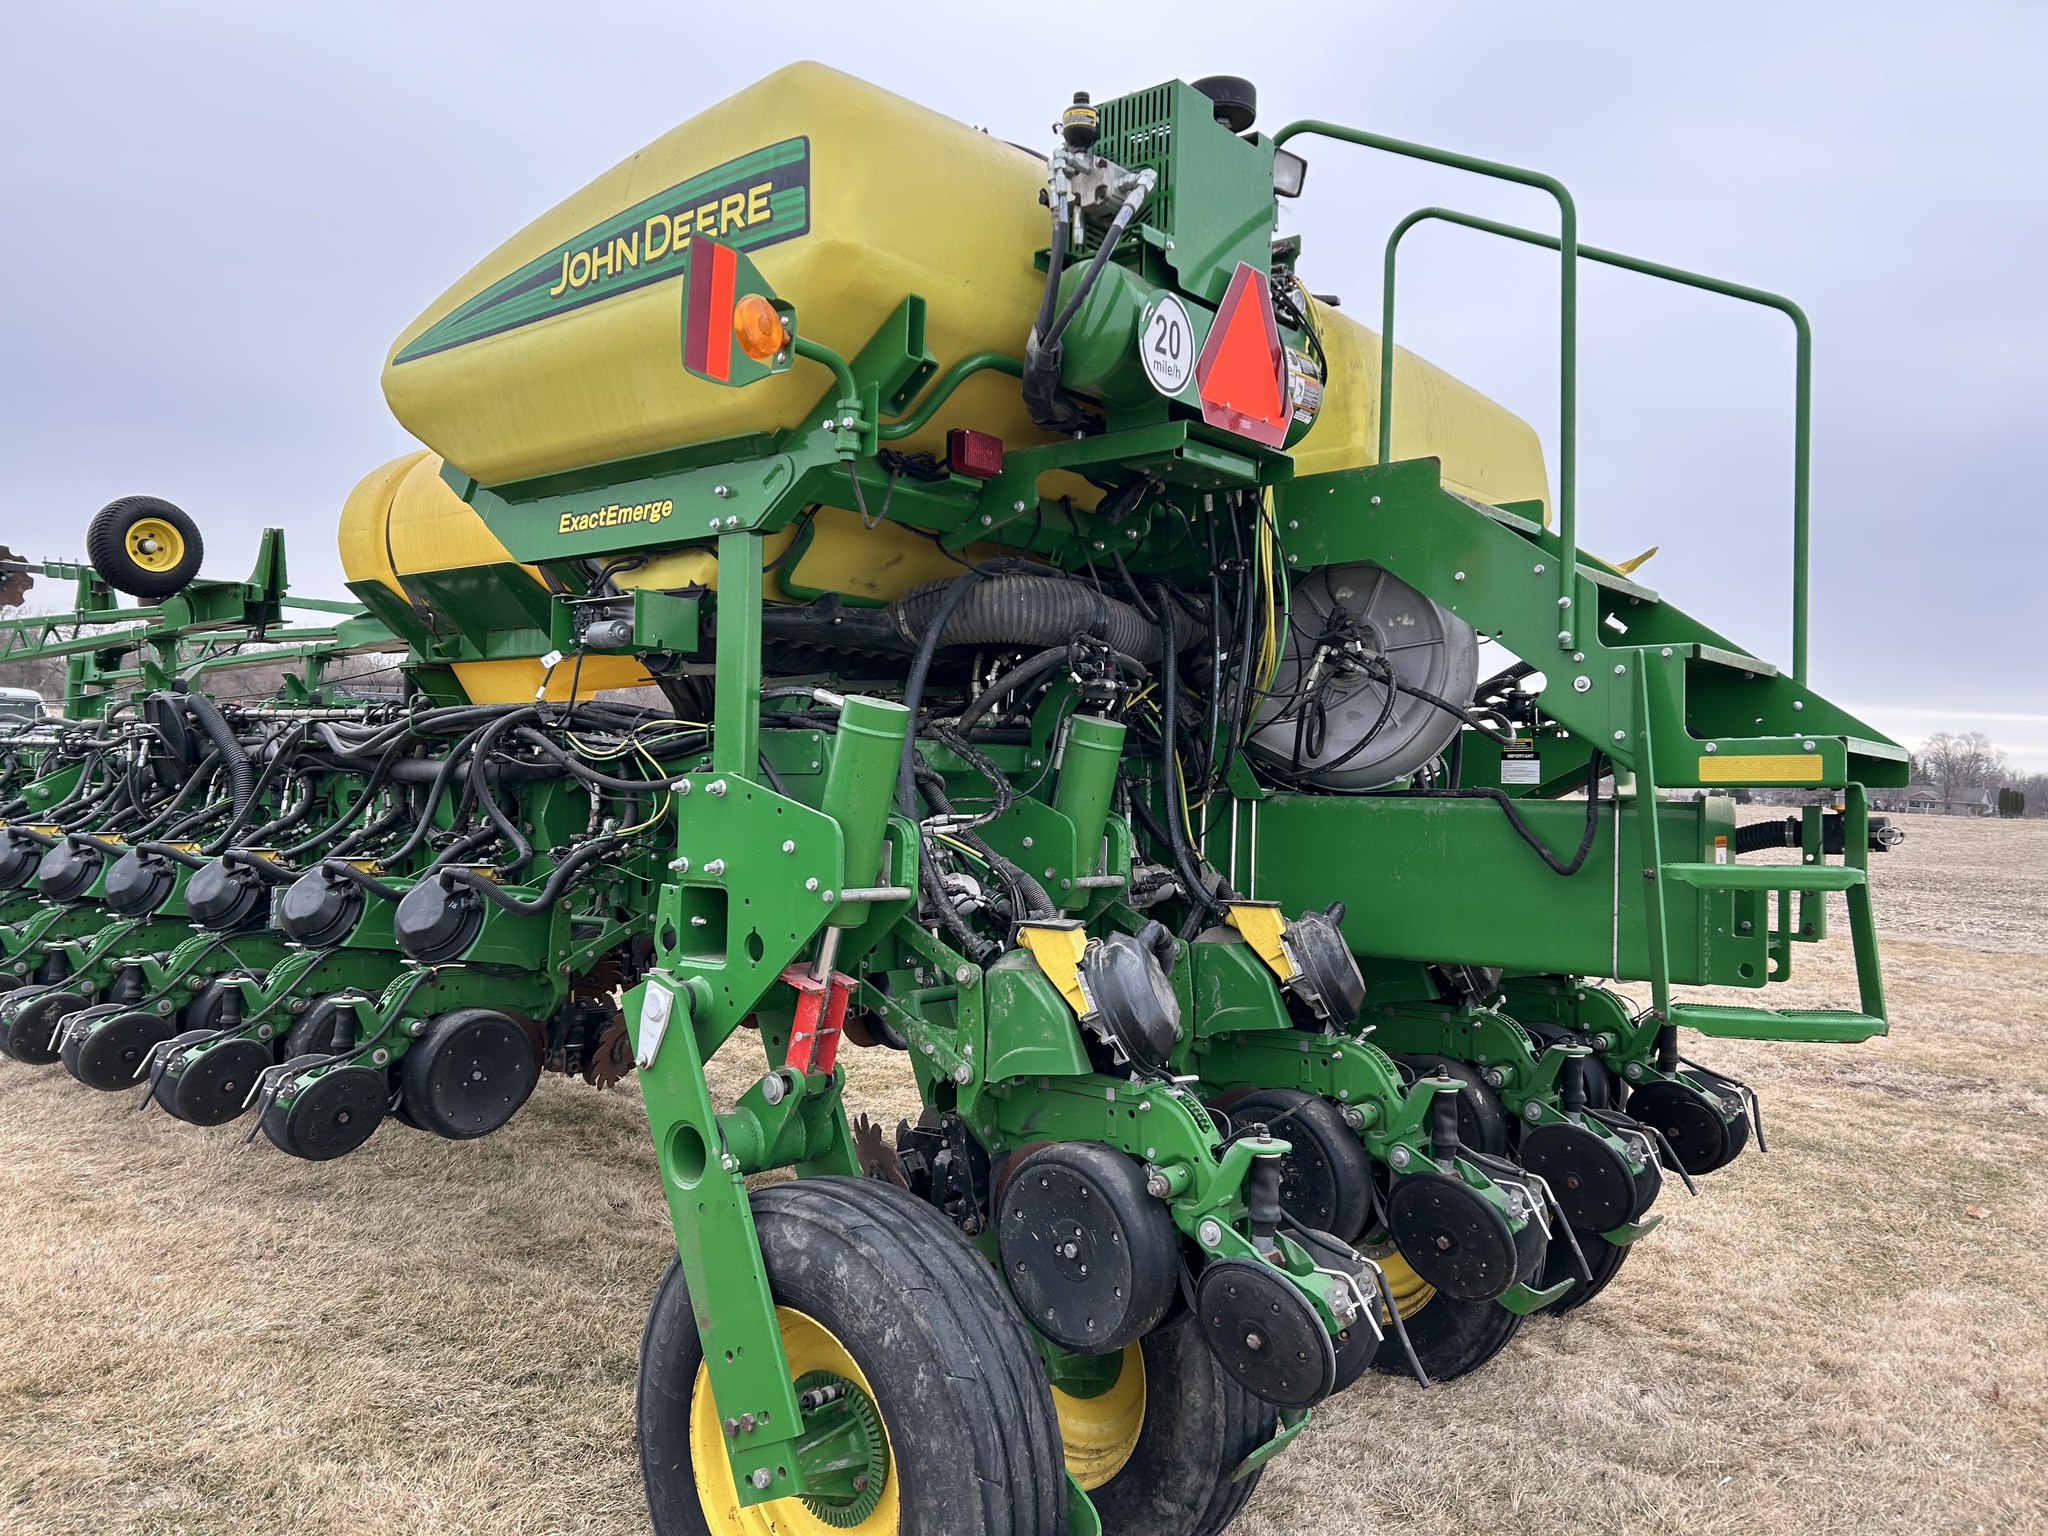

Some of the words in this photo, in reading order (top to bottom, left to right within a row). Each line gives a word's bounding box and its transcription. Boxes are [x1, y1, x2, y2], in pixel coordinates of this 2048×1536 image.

[550, 231, 639, 296] JOHN
[644, 181, 773, 262] DEERE
[1154, 314, 1181, 360] 20
[1153, 359, 1181, 379] mile/h
[558, 499, 674, 534] ExactEmerge
[448, 900, 458, 909] 18
